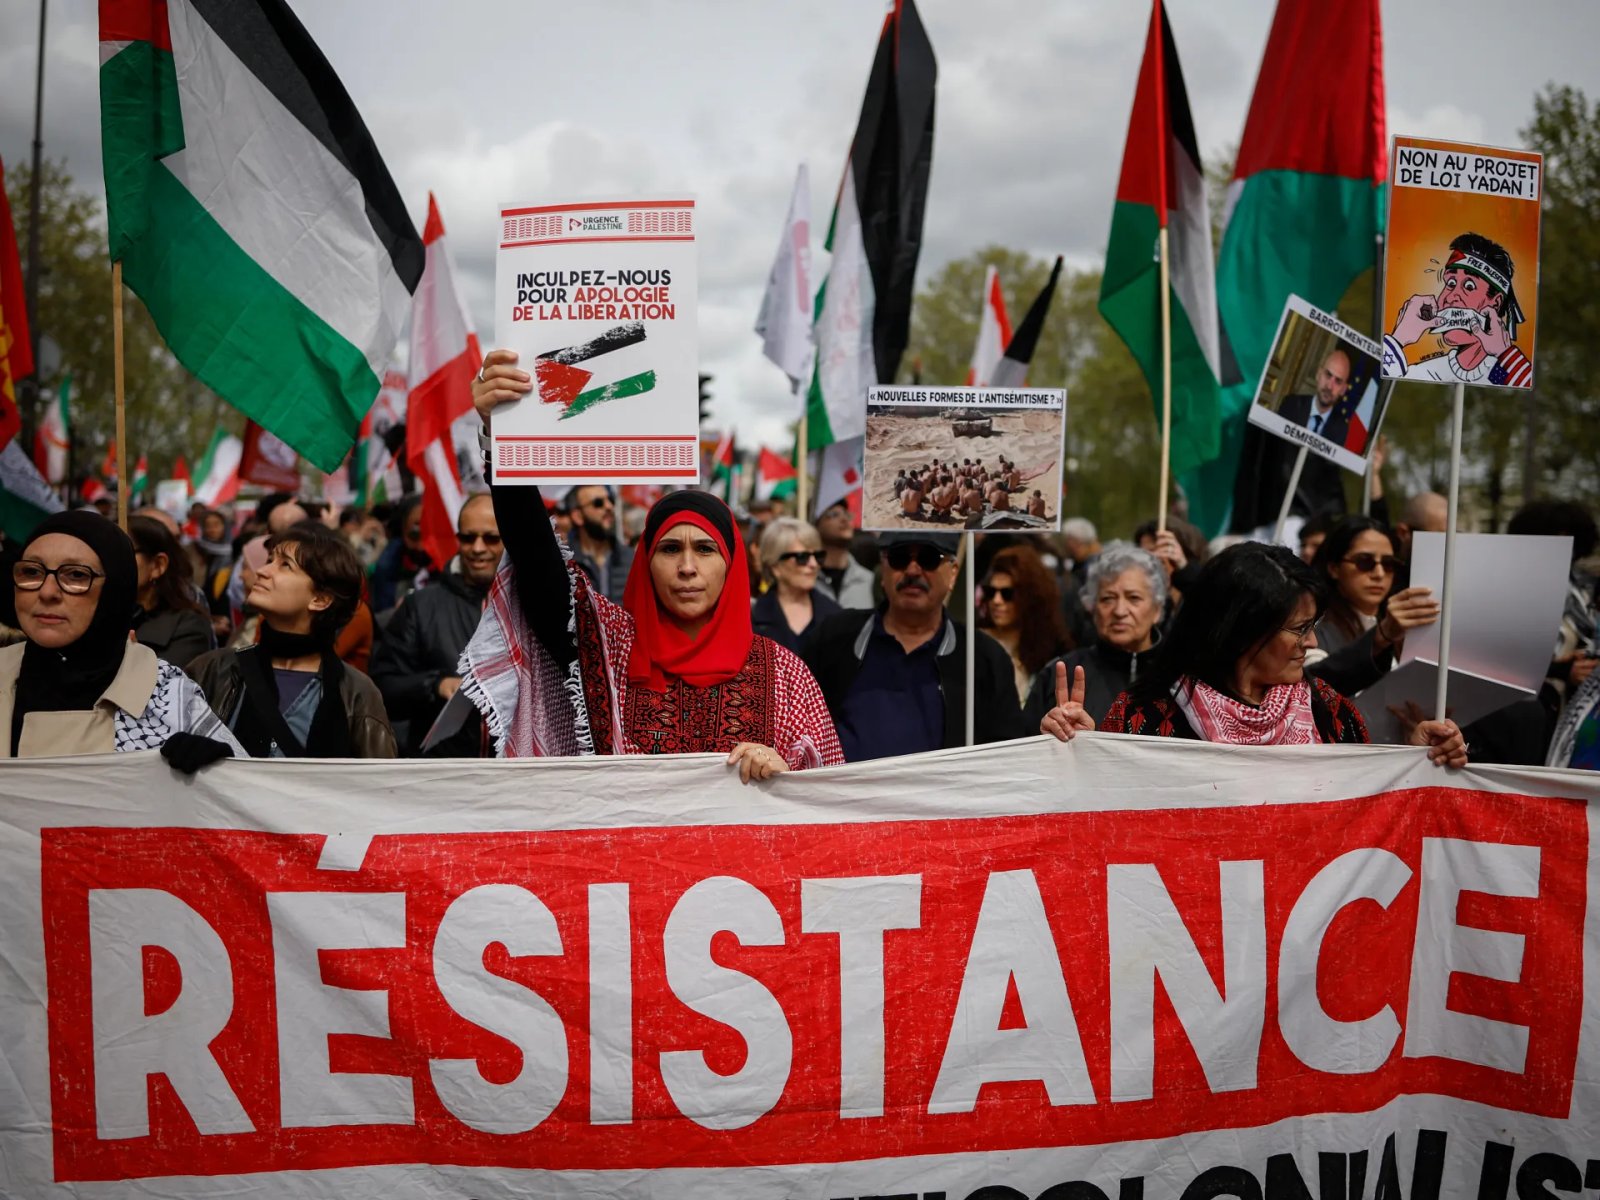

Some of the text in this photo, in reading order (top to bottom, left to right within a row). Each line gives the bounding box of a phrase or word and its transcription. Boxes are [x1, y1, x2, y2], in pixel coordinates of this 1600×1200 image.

[1399, 149, 1537, 180] NON AU PROJET
[1401, 168, 1534, 197] DE LOI YADAN !
[517, 270, 671, 288] INCULPEZ-NOUS
[1467, 256, 1508, 288] FREE PALESTINE
[518, 286, 669, 304] POUR APOLOGIE
[512, 305, 534, 321] DE
[539, 304, 562, 321] LA
[1309, 308, 1344, 333] BARROT
[877, 391, 926, 403] NOUVELLES
[930, 392, 964, 403] FORMES
[965, 393, 976, 403] DE
[979, 390, 1049, 405] L'ANTISÉMITISME
[1050, 394, 1055, 405] ?
[1283, 423, 1332, 455] DÉMISSION
[88, 834, 1541, 1140] RÉSISTANCE
